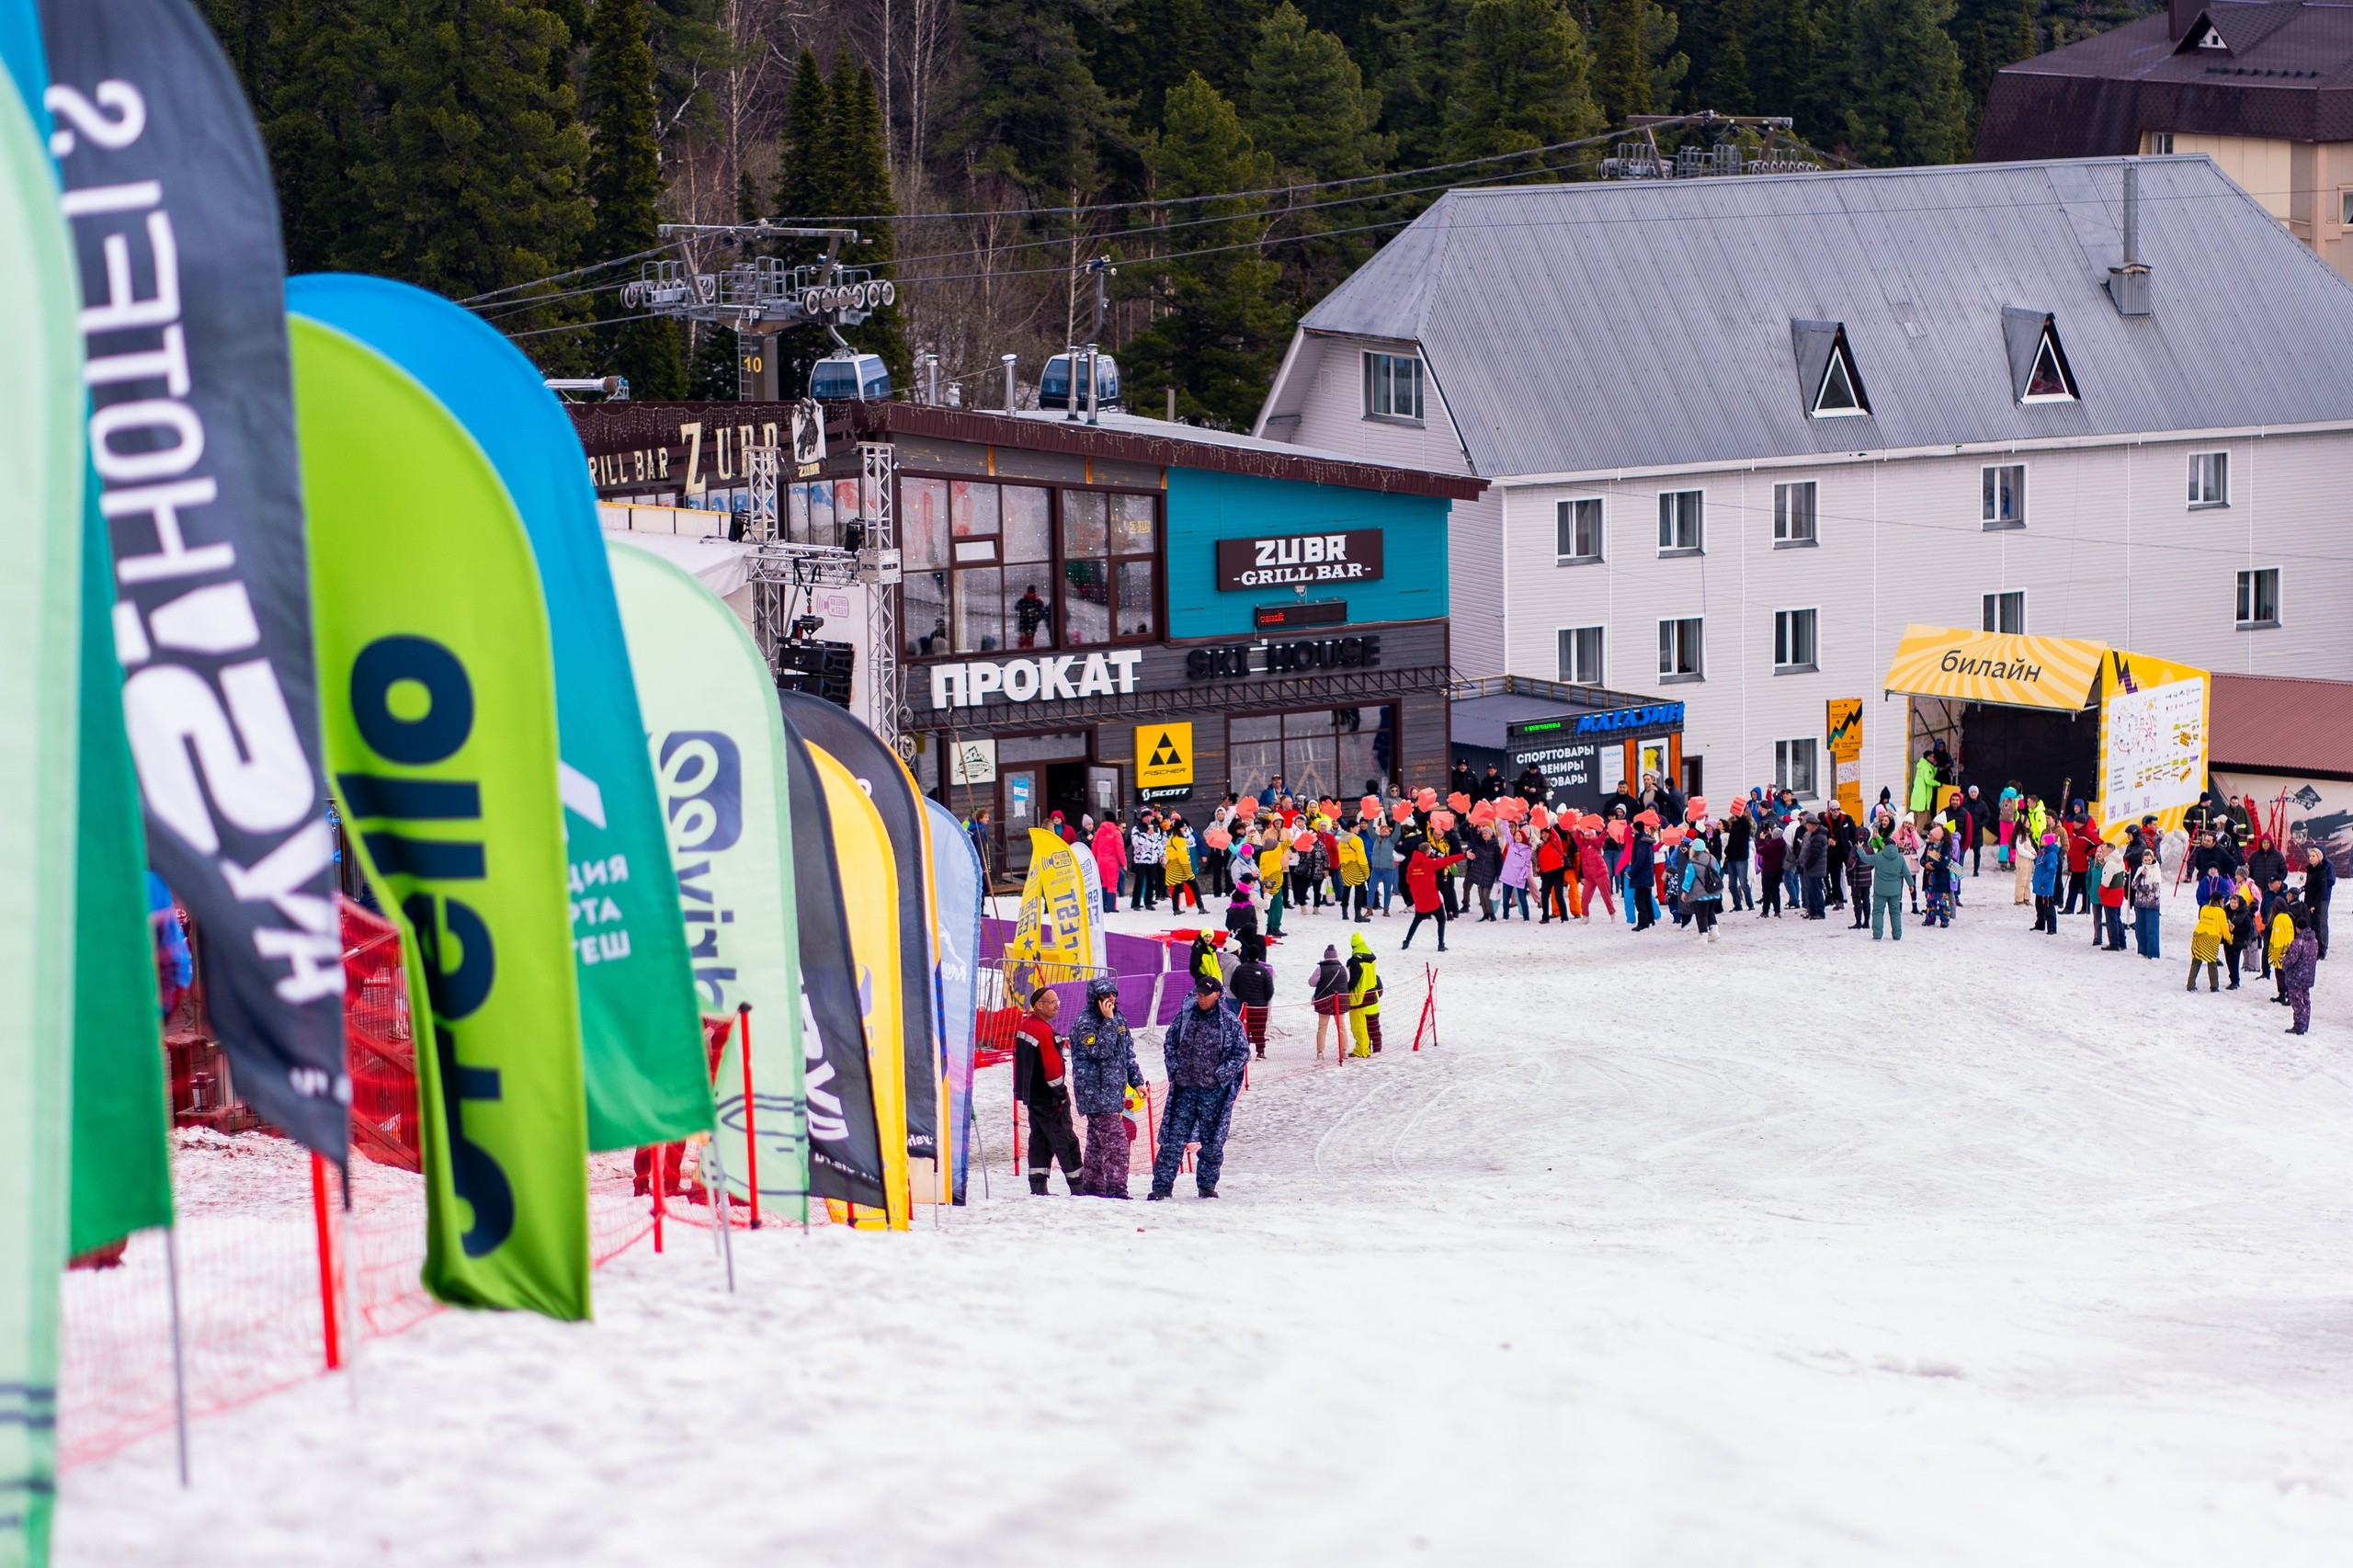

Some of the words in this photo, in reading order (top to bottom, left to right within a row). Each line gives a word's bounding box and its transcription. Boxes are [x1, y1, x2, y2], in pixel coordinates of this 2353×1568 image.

[744, 357, 763, 373] 10
[589, 453, 629, 487] RILL
[633, 447, 670, 482] BAR
[798, 463, 821, 476] ZUBR
[1255, 534, 1347, 567] ZUBR
[1187, 646, 1249, 680] SKI
[1267, 635, 1381, 674] HOUSE
[1941, 650, 2041, 682] билайн
[930, 649, 1142, 710] ПРОКАТ
[1576, 703, 1685, 734] МАГАЗИН
[1517, 744, 1594, 764] СПОРТТОВАРЫ
[1143, 767, 1187, 776] FISCHER
[1540, 760, 1584, 775] ВЕНИРЫ
[1151, 788, 1189, 798] SCOTT
